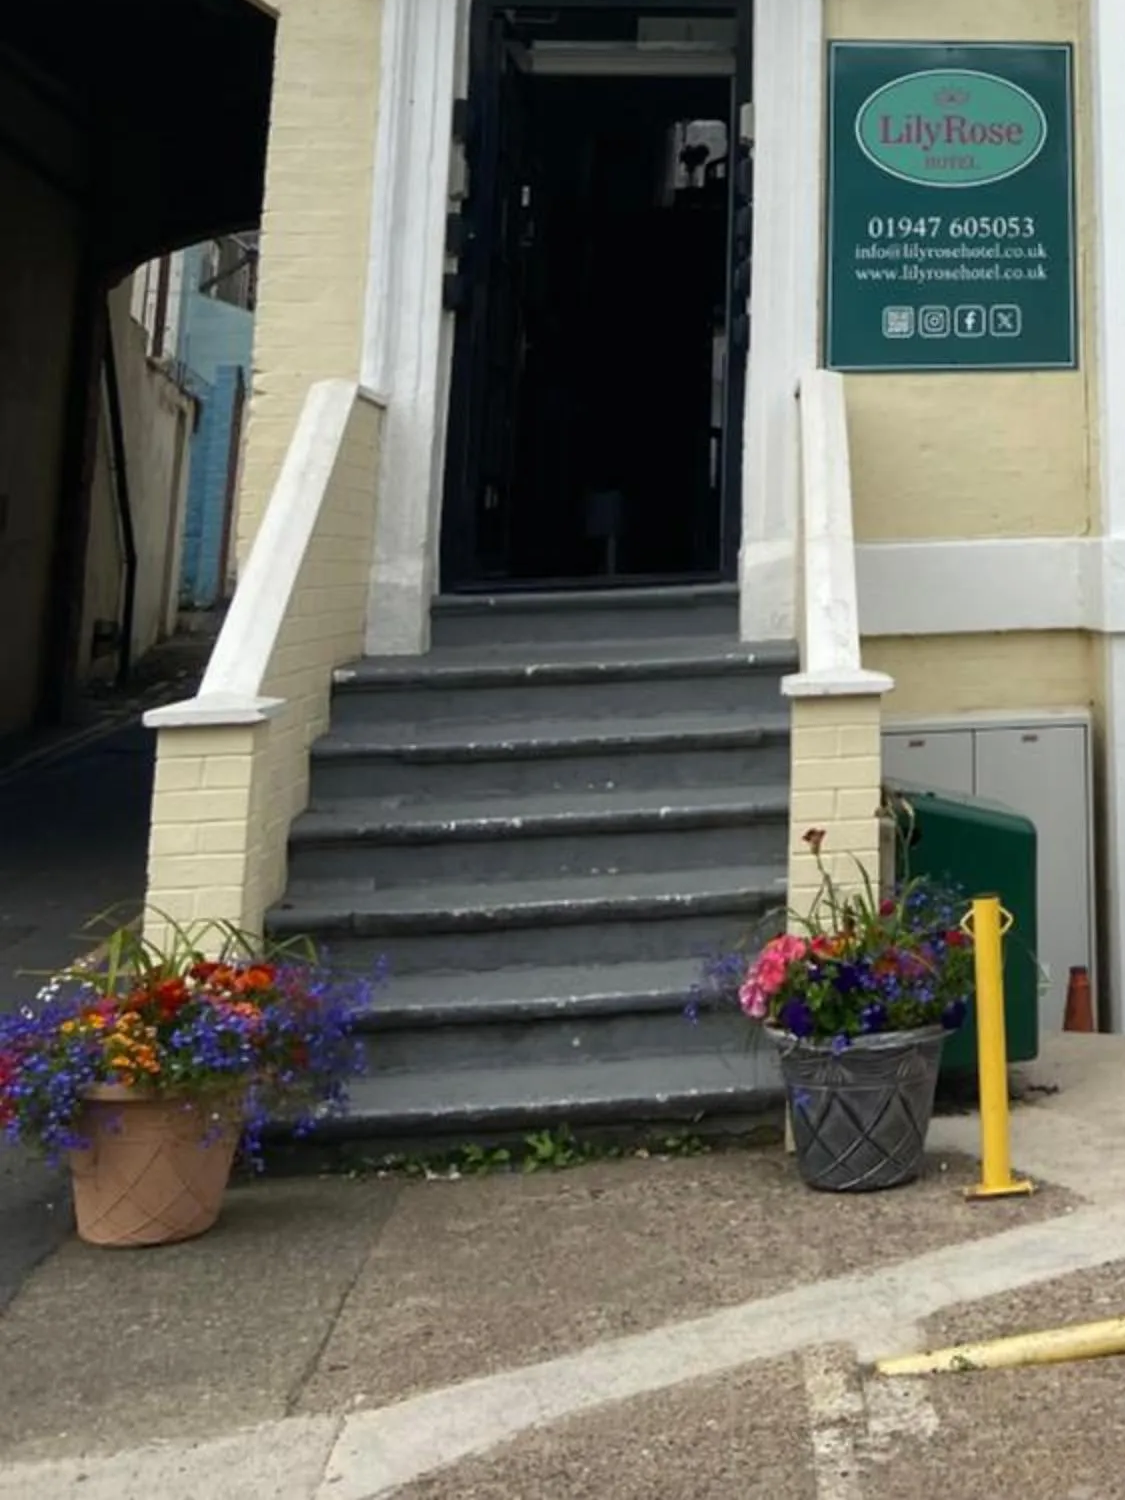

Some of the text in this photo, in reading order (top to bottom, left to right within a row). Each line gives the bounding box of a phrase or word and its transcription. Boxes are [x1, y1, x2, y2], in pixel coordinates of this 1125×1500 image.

[879, 114, 1023, 150] LilyRose
[868, 217, 1035, 238] 01947 605053
[855, 243, 1047, 262] info@lilyrosehotel.co.uk
[855, 264, 1047, 283] www.lilyrosehotel.co.uk
